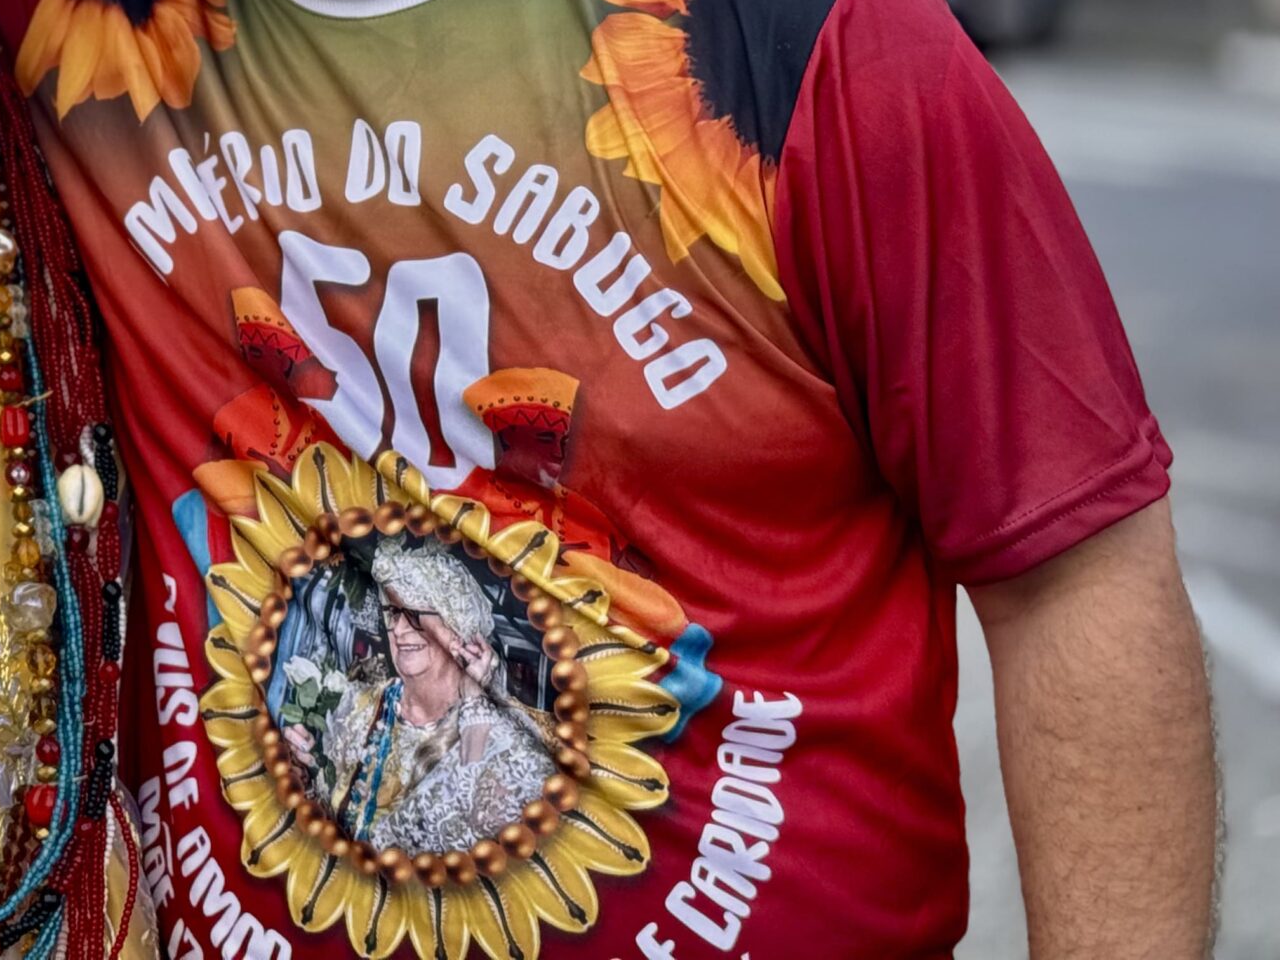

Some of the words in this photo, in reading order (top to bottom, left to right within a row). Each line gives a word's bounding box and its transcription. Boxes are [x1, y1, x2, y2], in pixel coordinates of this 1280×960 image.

[125, 127, 322, 280] MÉRIO
[344, 118, 421, 206] DO
[443, 133, 727, 410] SABUGO
[279, 230, 496, 490] 50
[163, 741, 199, 812] DE
[664, 690, 803, 952] CARIDADE
